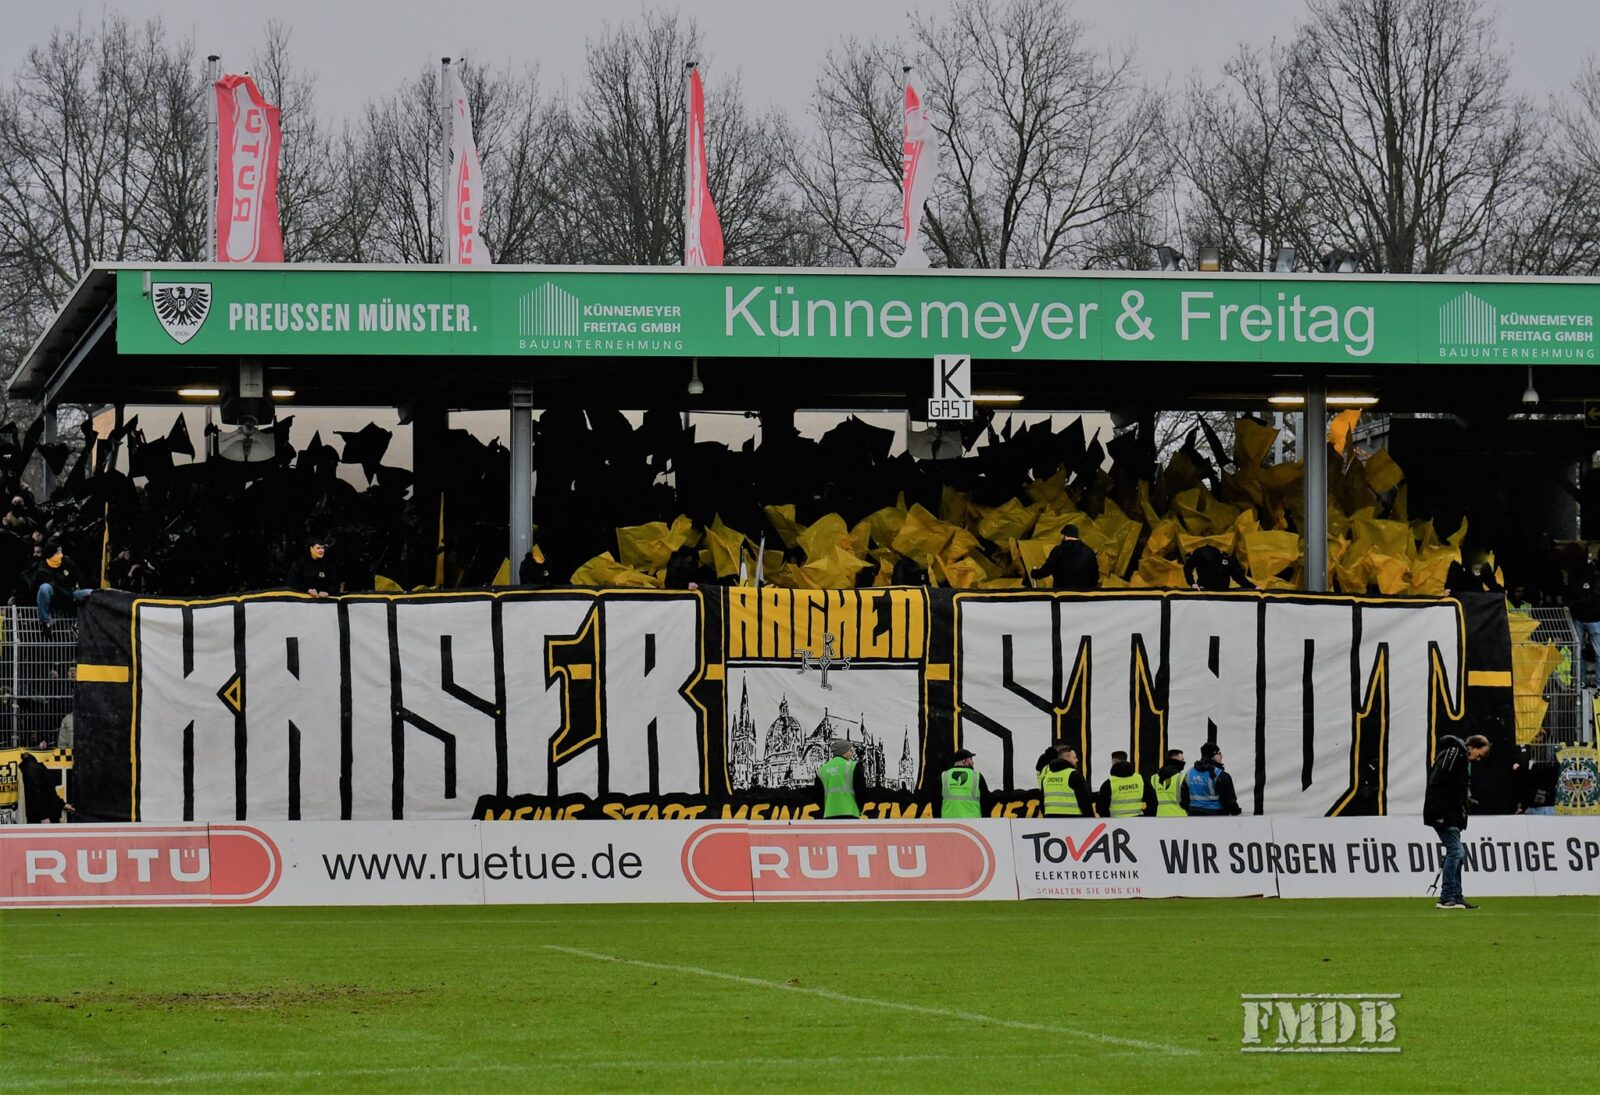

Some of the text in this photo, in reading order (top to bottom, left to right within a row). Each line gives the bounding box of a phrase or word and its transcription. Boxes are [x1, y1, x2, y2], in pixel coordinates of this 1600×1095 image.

[229, 297, 478, 333] PREUSSEN MÜNSTER.
[583, 303, 681, 317] KÜNNEMEYER
[1500, 312, 1593, 326] KÜNNEMEYER
[583, 322, 681, 333] FREITAG GMBH
[725, 286, 1375, 356] Künnemeyer & Freitag
[519, 339, 683, 350] BAUUNTERNEHMUNG
[1500, 331, 1593, 342] FREITAG GMBH
[1439, 347, 1595, 358] BAUUNTERNEHMUNG
[941, 359, 966, 399] K
[930, 400, 971, 418] GAST
[140, 599, 701, 820] KAISER
[322, 843, 643, 881] www.ruetue.de
[750, 844, 928, 880] RÜTÜ
[1160, 838, 1220, 874] WIR
[1230, 841, 1336, 874] SORGEN
[1347, 837, 1400, 873] FÜR
[1463, 837, 1558, 872] NÖTIGE
[25, 847, 210, 885] RÜTÜ
[1035, 870, 1140, 880] ELEKTROTECHNIK
[1037, 887, 1082, 895] SCHALTEN
